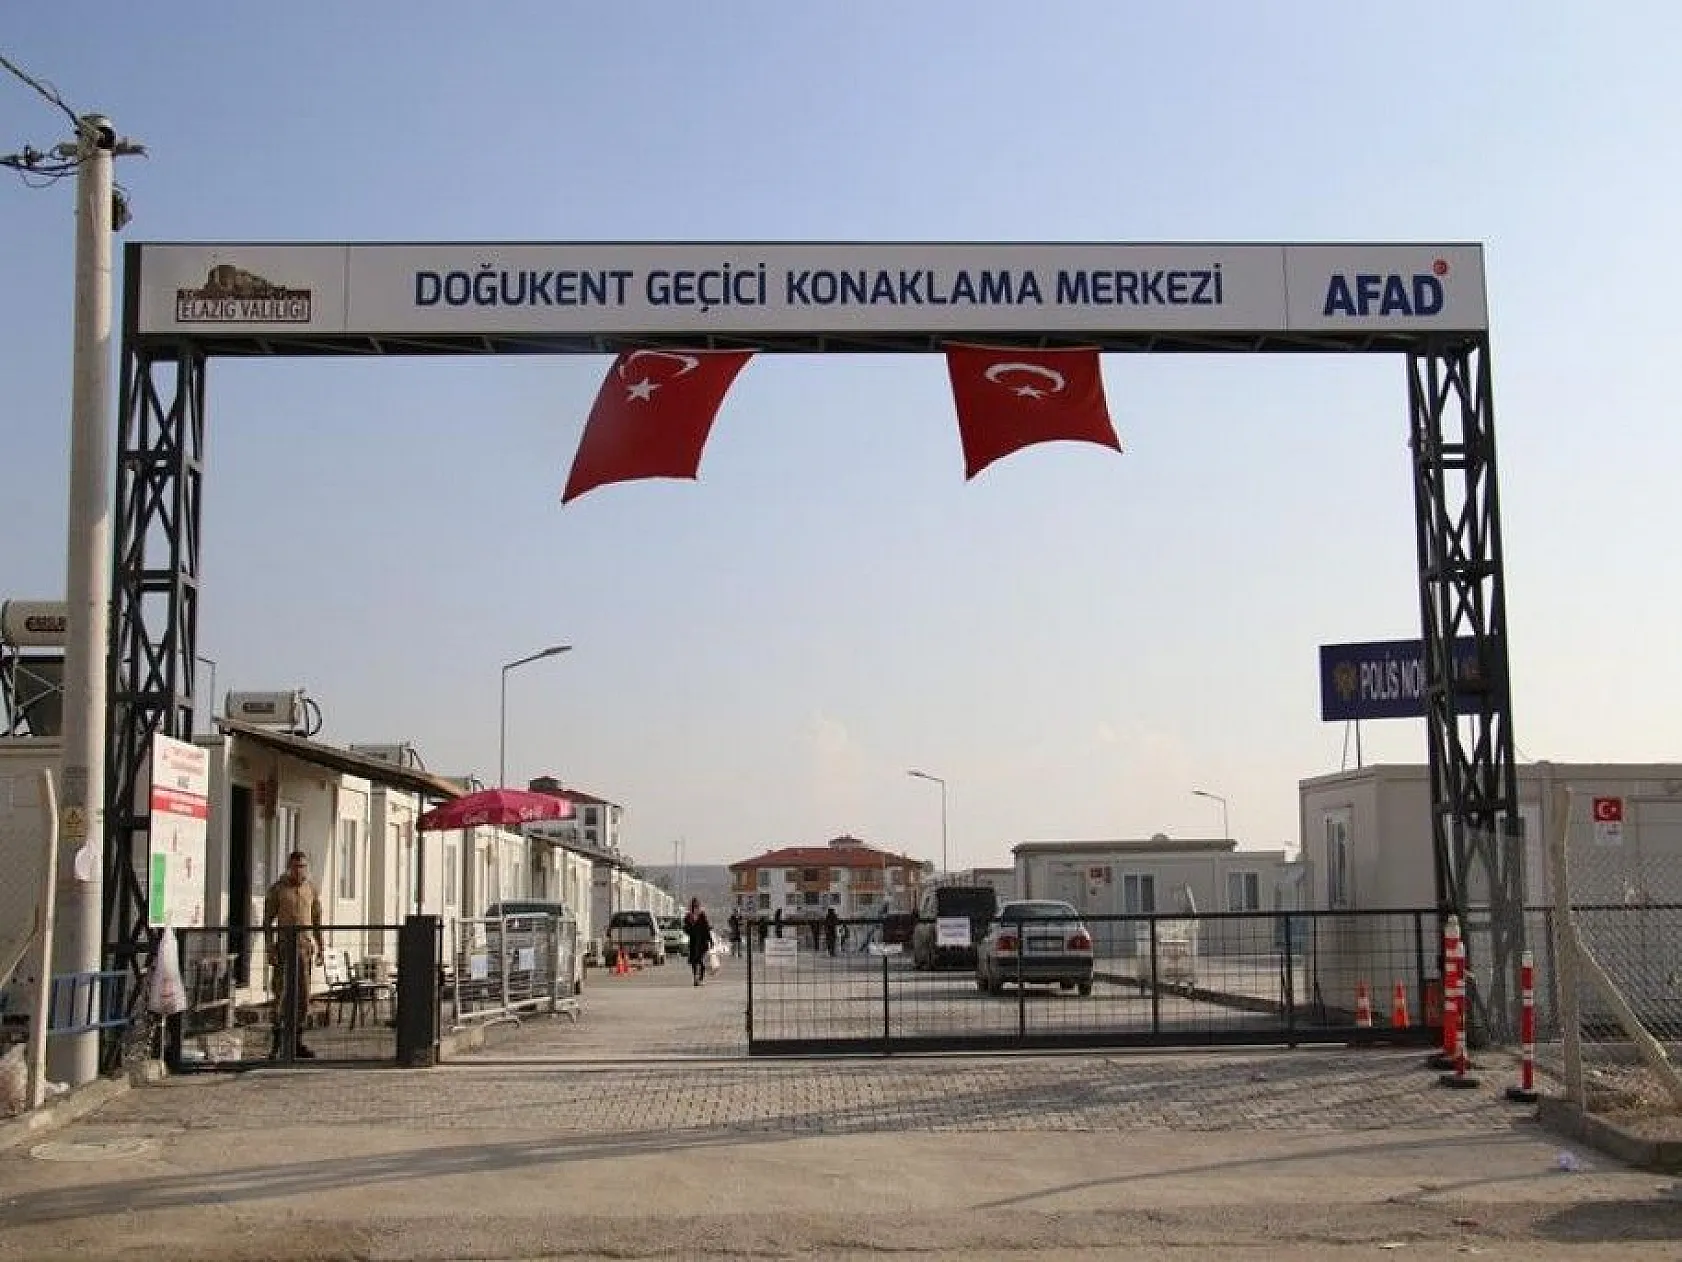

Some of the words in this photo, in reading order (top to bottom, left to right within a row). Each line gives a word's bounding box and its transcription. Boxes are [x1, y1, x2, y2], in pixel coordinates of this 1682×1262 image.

[416, 263, 633, 305] DOĞUKENT
[646, 263, 766, 313] GEÇİCİ
[787, 270, 1043, 304] KONAKLAMA
[1056, 263, 1222, 304] MERKEZİ
[1323, 274, 1443, 316] AFAD
[1360, 651, 1400, 701] POLİS
